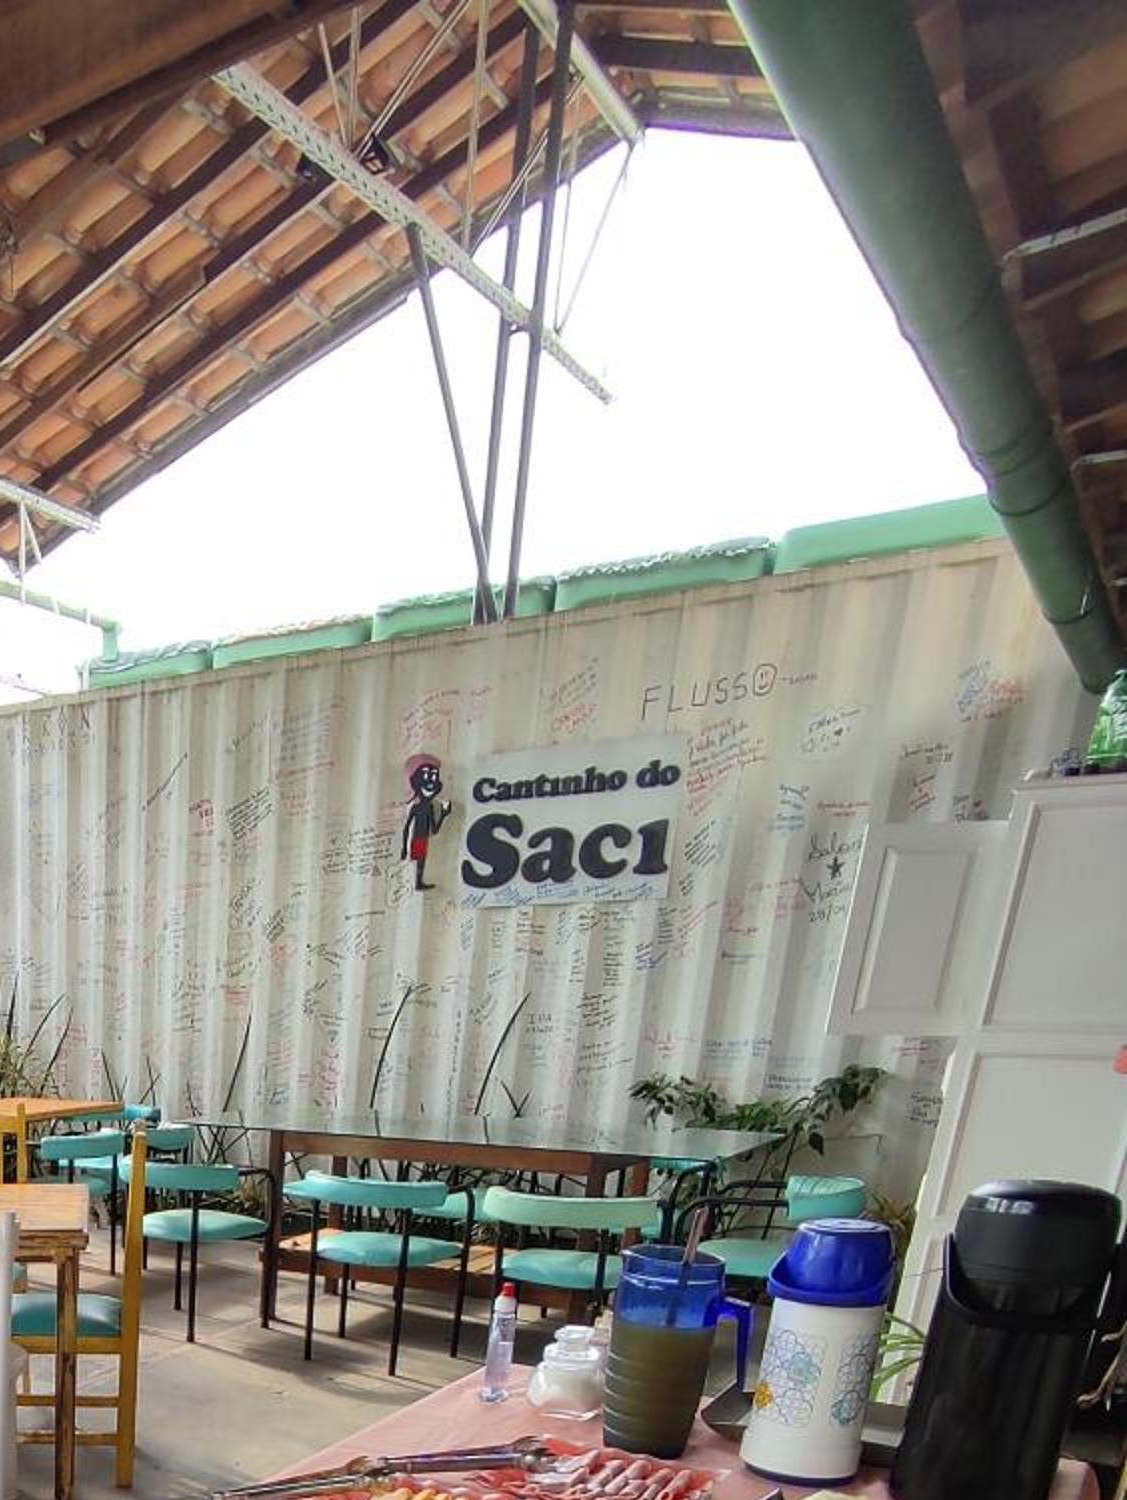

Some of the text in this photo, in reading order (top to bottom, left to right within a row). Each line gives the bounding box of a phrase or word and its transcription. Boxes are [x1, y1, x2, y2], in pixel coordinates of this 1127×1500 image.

[473, 759, 681, 803] Cantinho do
[461, 812, 670, 889] Saci
